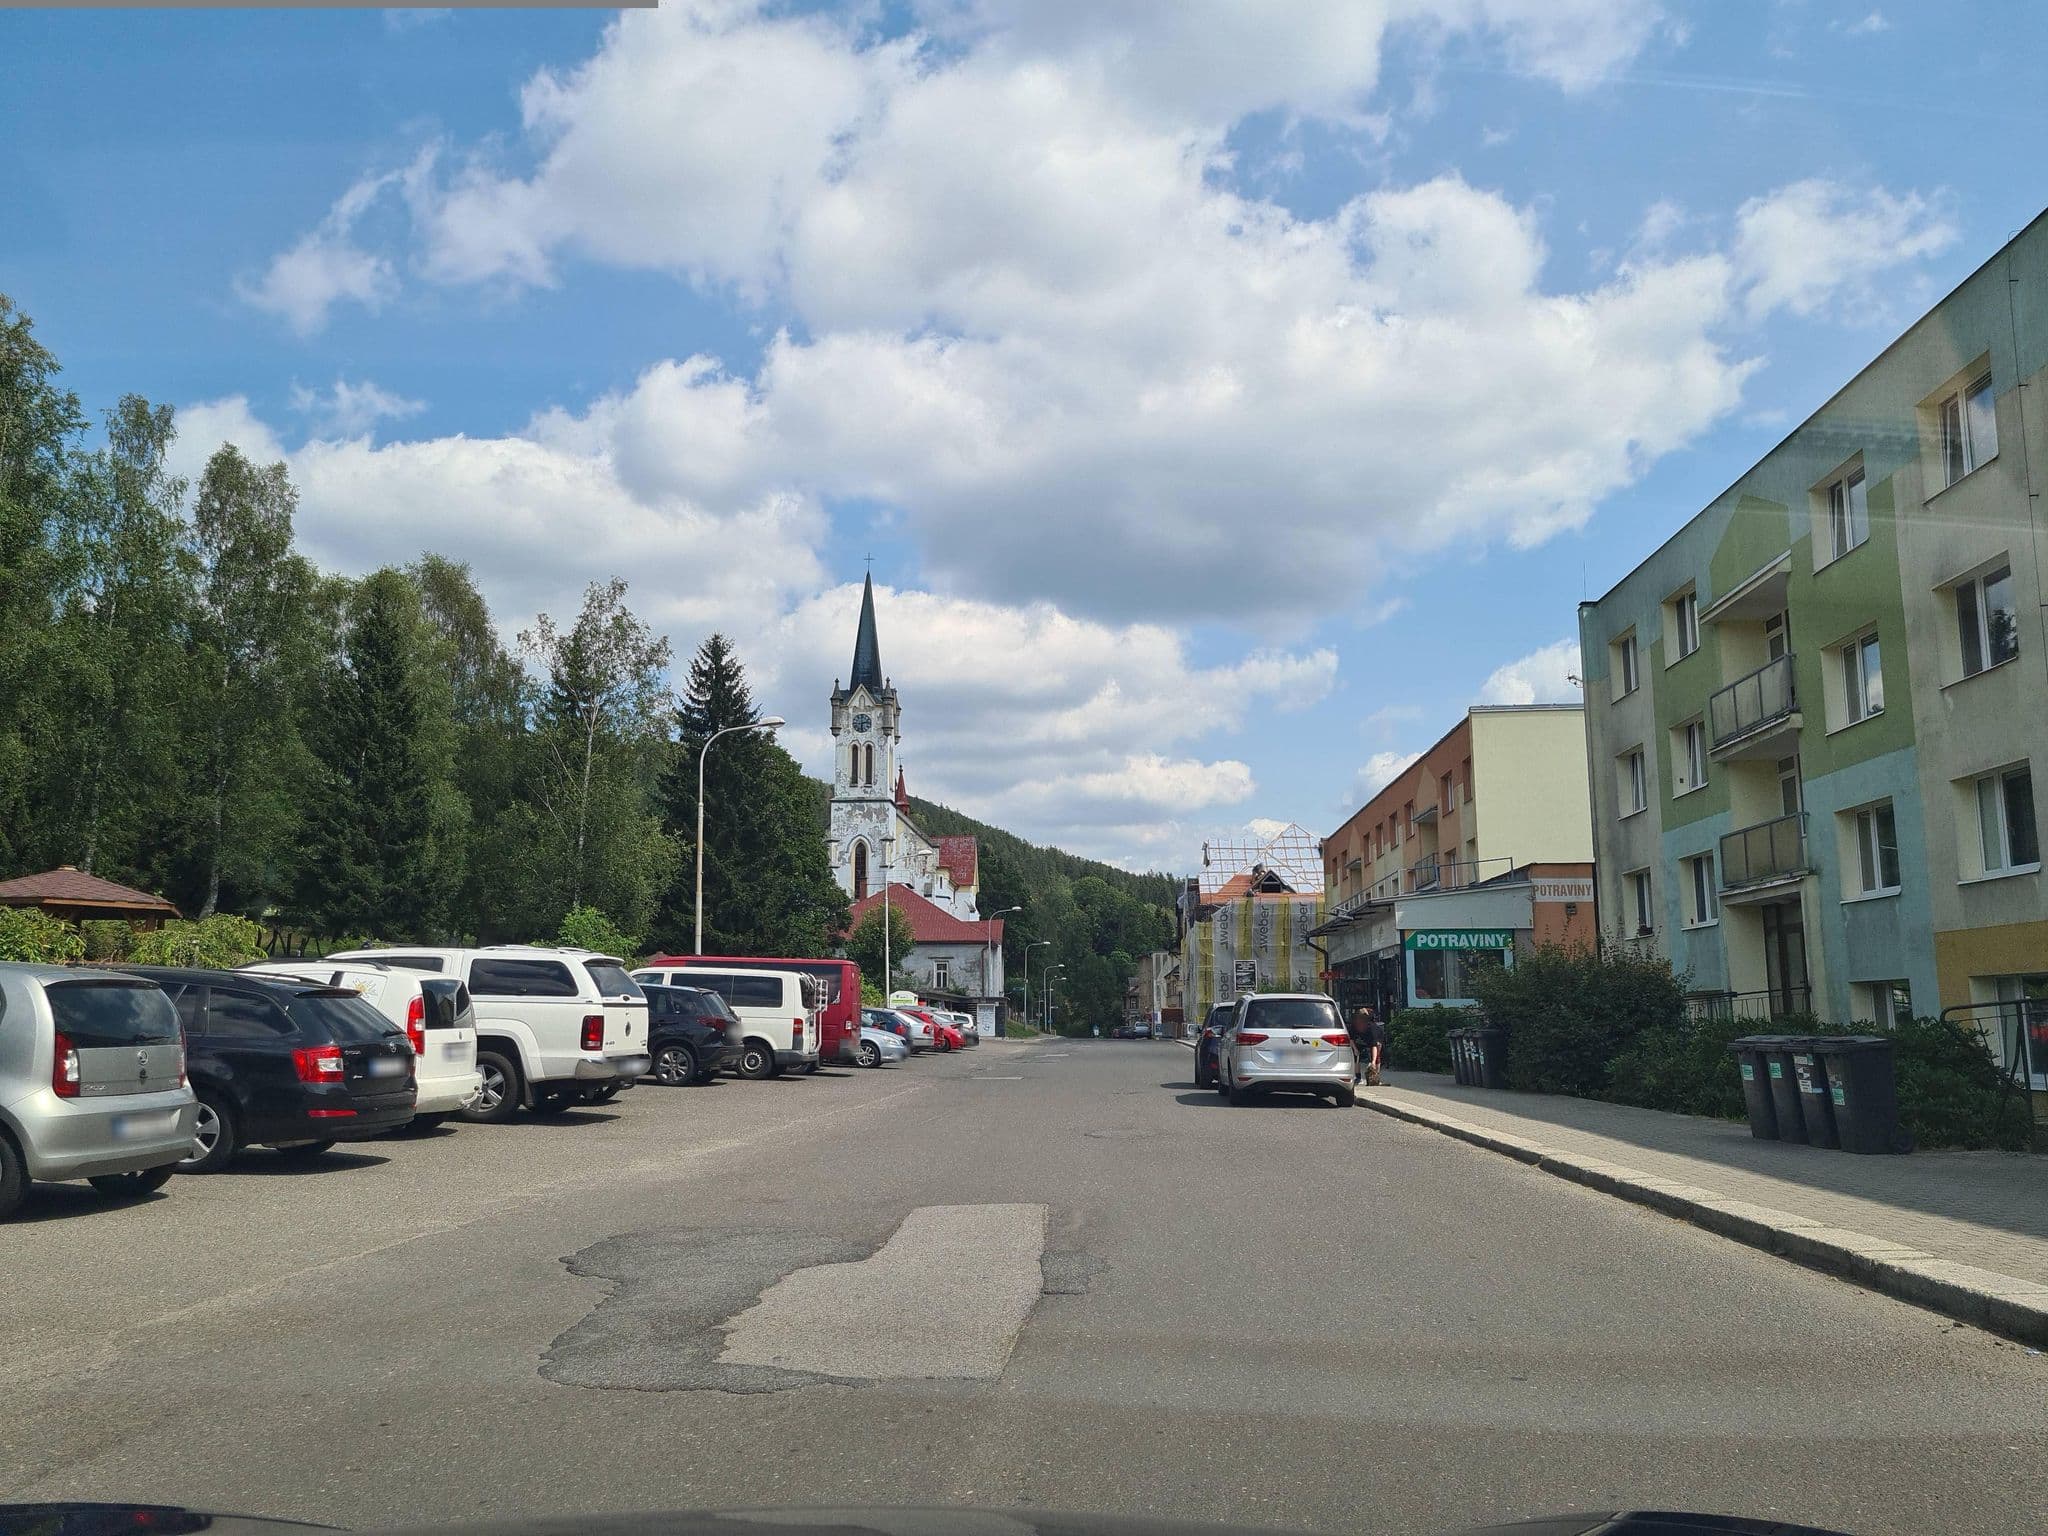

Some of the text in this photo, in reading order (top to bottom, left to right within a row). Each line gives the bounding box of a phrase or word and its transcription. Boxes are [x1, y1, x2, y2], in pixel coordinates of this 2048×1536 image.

[1534, 885, 1591, 897] POTRAVINY
[1217, 907, 1229, 944] webe
[1259, 905, 1269, 945] weber
[1297, 902, 1309, 944] weber
[1417, 933, 1505, 948] POTRAVINY
[1219, 970, 1230, 1002] eber
[1297, 970, 1307, 992] ber
